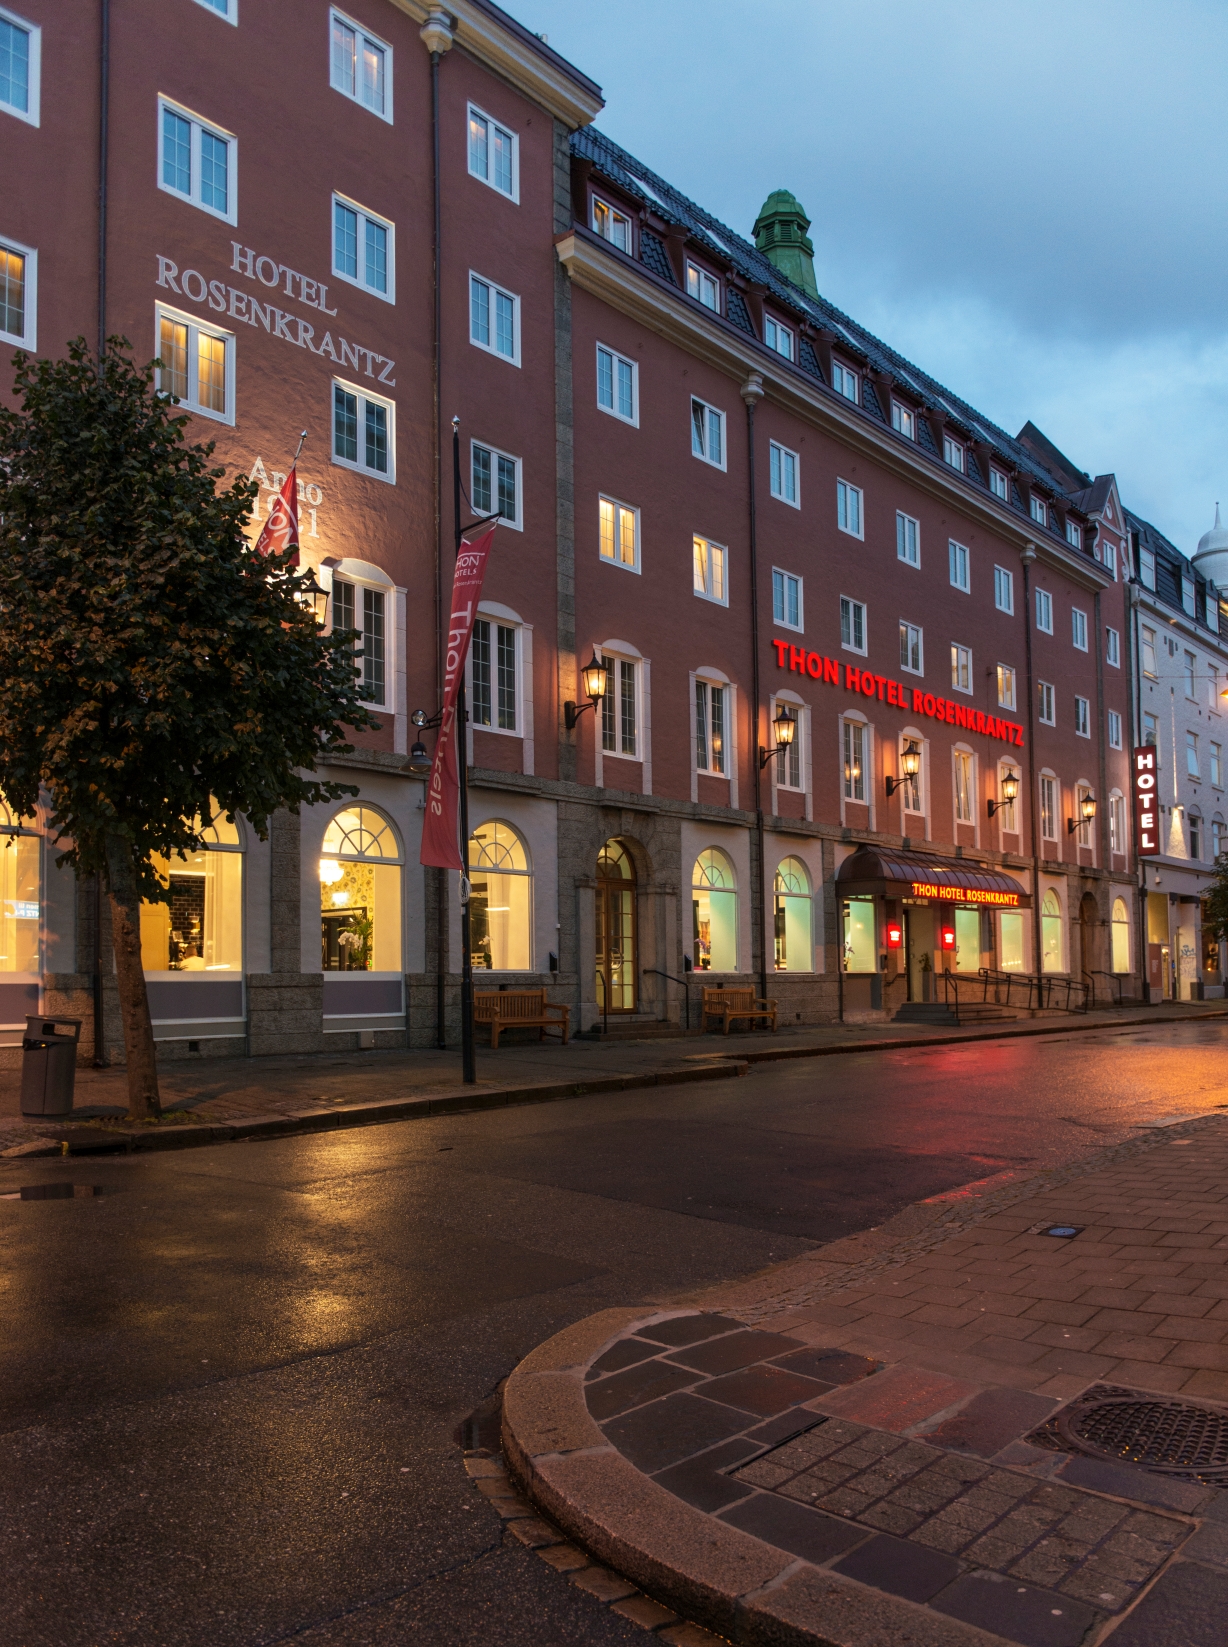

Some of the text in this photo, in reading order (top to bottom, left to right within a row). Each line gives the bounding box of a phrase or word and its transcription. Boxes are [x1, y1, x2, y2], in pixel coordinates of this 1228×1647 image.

[155, 253, 397, 387] ROSENKRANTZ
[230, 240, 338, 317] HOTEL
[772, 639, 1024, 747] THON HOTEL ROSENKRANTZ
[1137, 753, 1155, 848] HOTEL
[913, 883, 1019, 906] THON HOTEL ROSENKRANTZ
